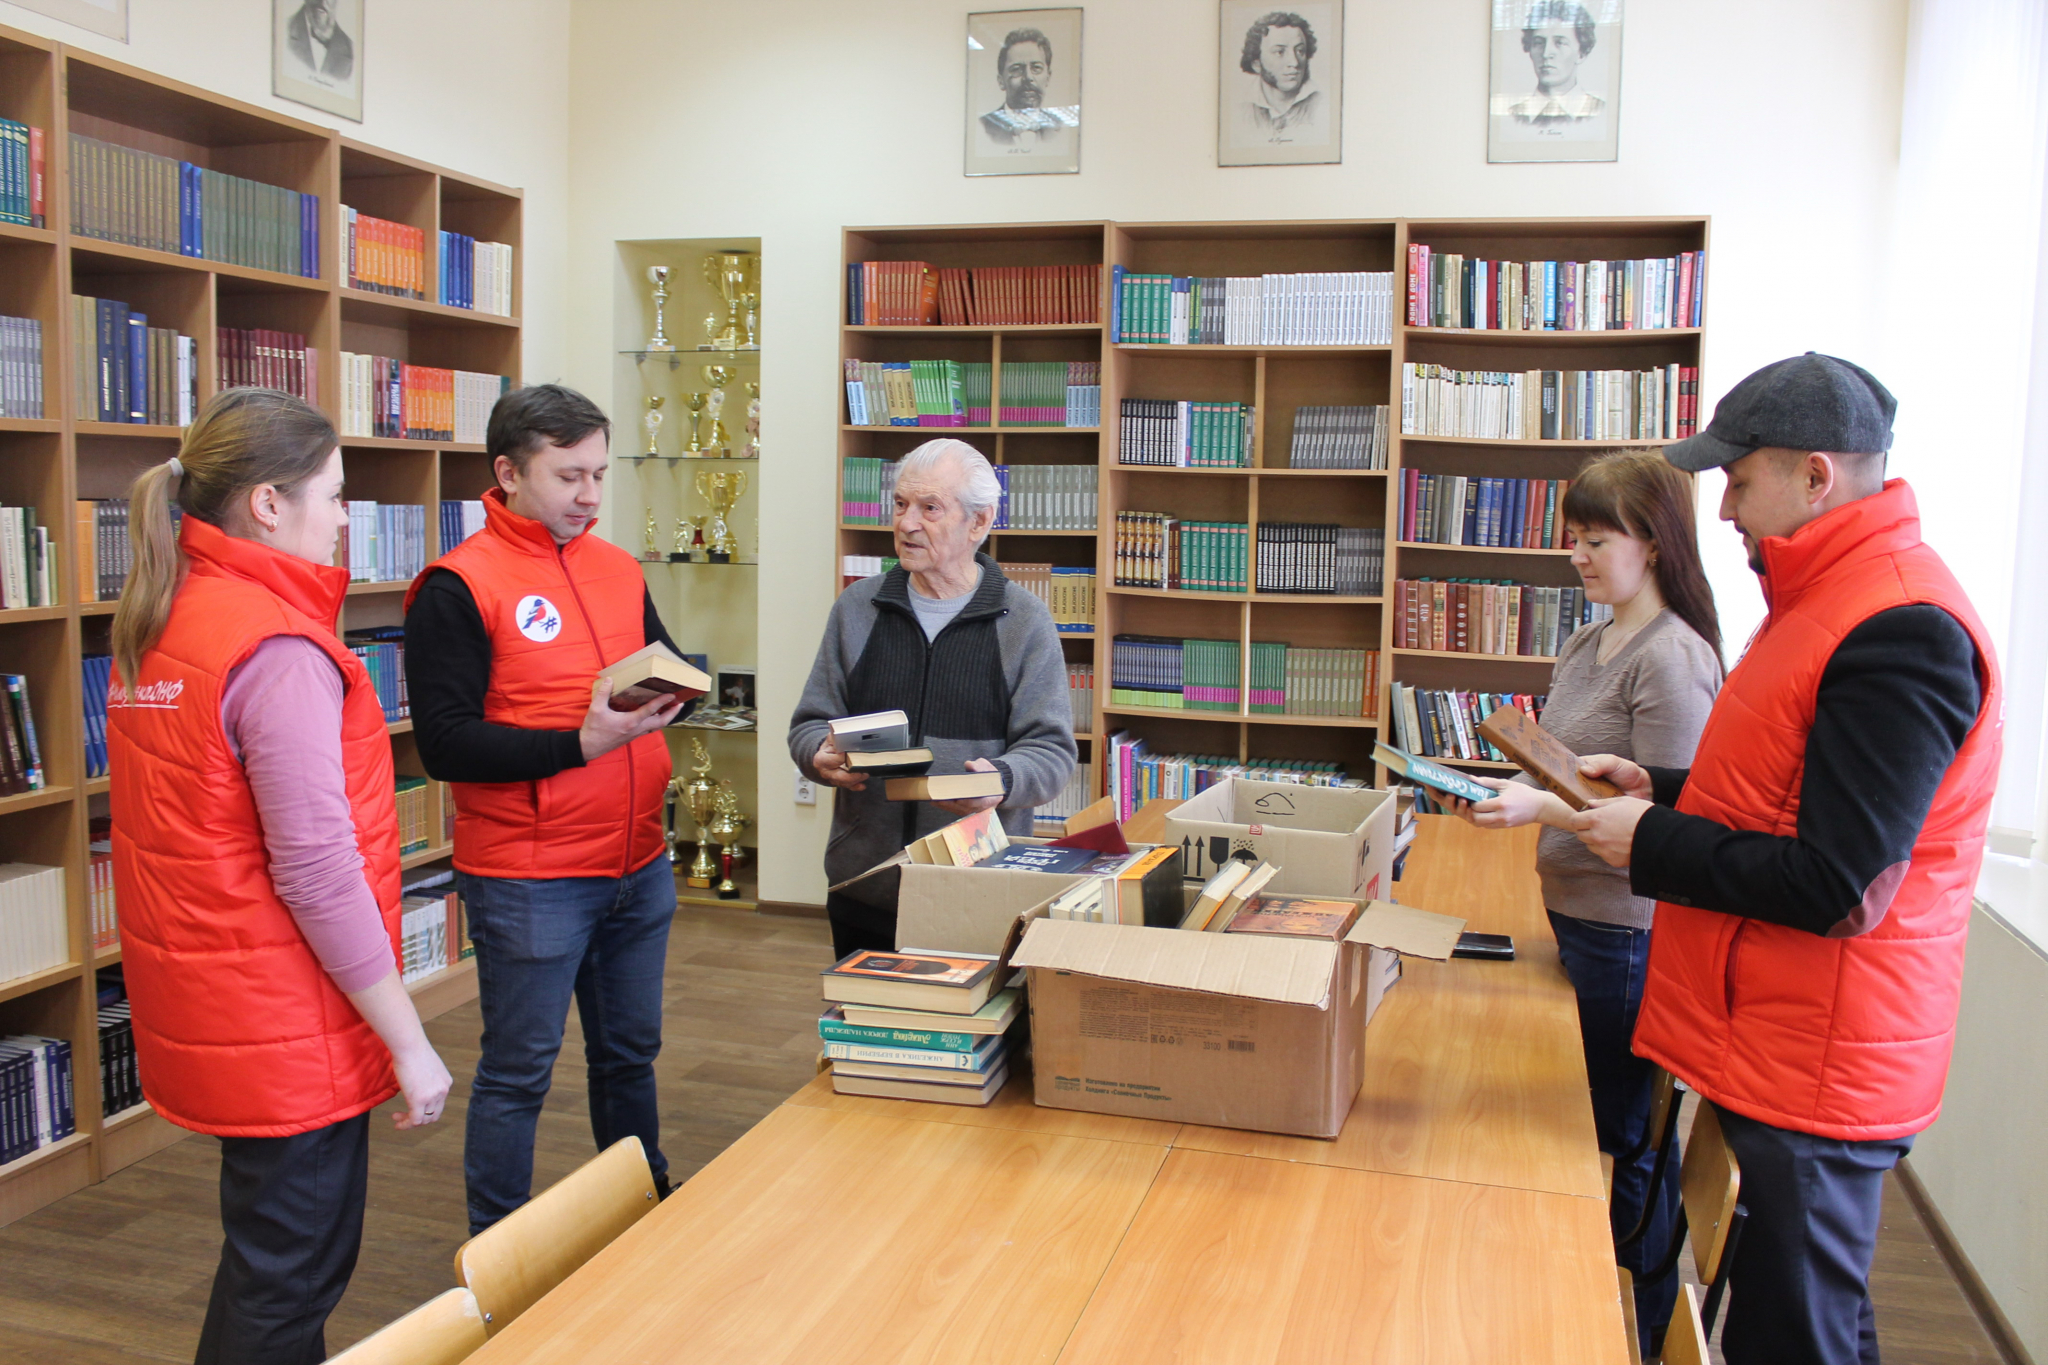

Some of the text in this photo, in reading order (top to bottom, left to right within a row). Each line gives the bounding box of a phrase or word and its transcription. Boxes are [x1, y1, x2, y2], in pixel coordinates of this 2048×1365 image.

[1545, 264, 1555, 319] Игорь Губерман
[1411, 762, 1489, 800] Тим Себастиан
[824, 1026, 889, 1040] ДОРОГА НАДЕЖДЫ
[1203, 1041, 1221, 1051] 33100
[857, 1050, 893, 1059] БЕРБЕРИИ
[902, 1053, 944, 1062] АНЖЕЛИКА
